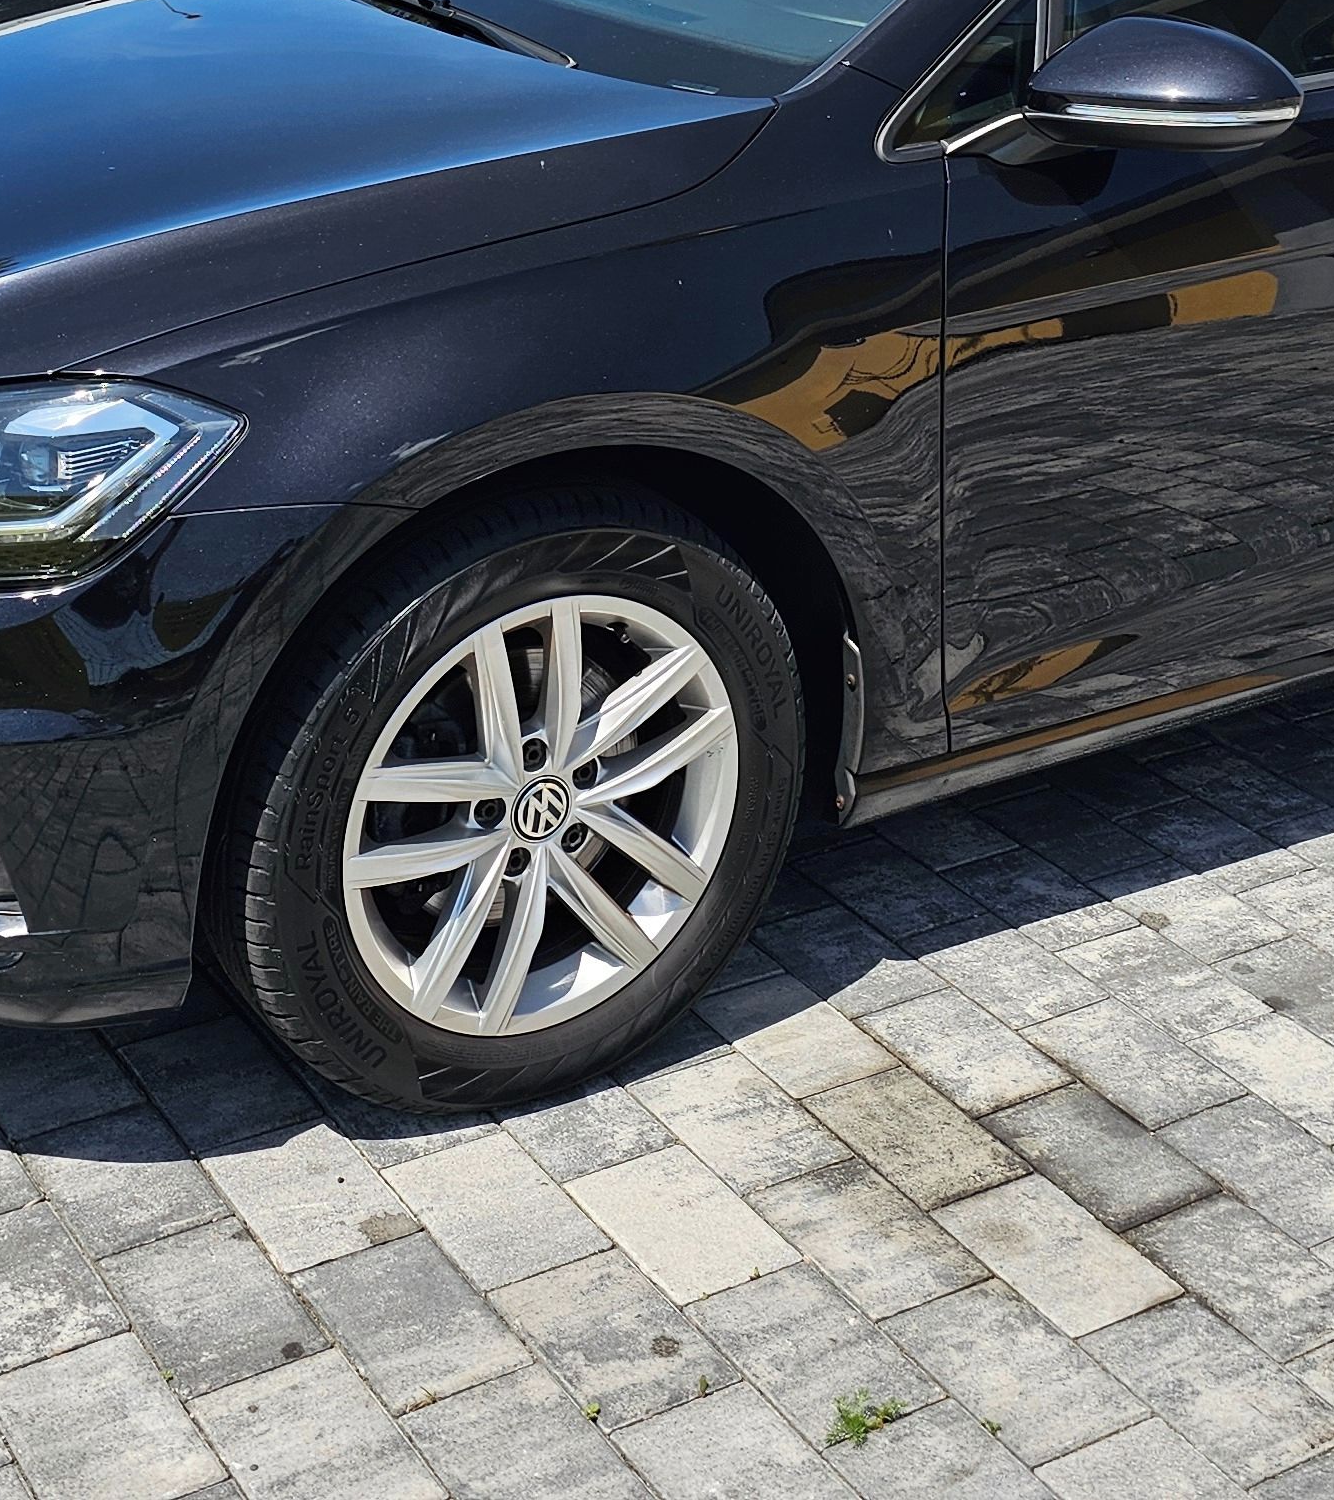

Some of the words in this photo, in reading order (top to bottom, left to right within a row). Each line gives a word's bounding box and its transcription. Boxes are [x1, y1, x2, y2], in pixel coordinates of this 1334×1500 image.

[714, 583, 787, 720] UNIROYAL
[294, 731, 350, 871] RainSport
[295, 928, 389, 1069] UNIROYAL
[325, 922, 347, 967] TYRE
[344, 976, 376, 1016] RAIN
